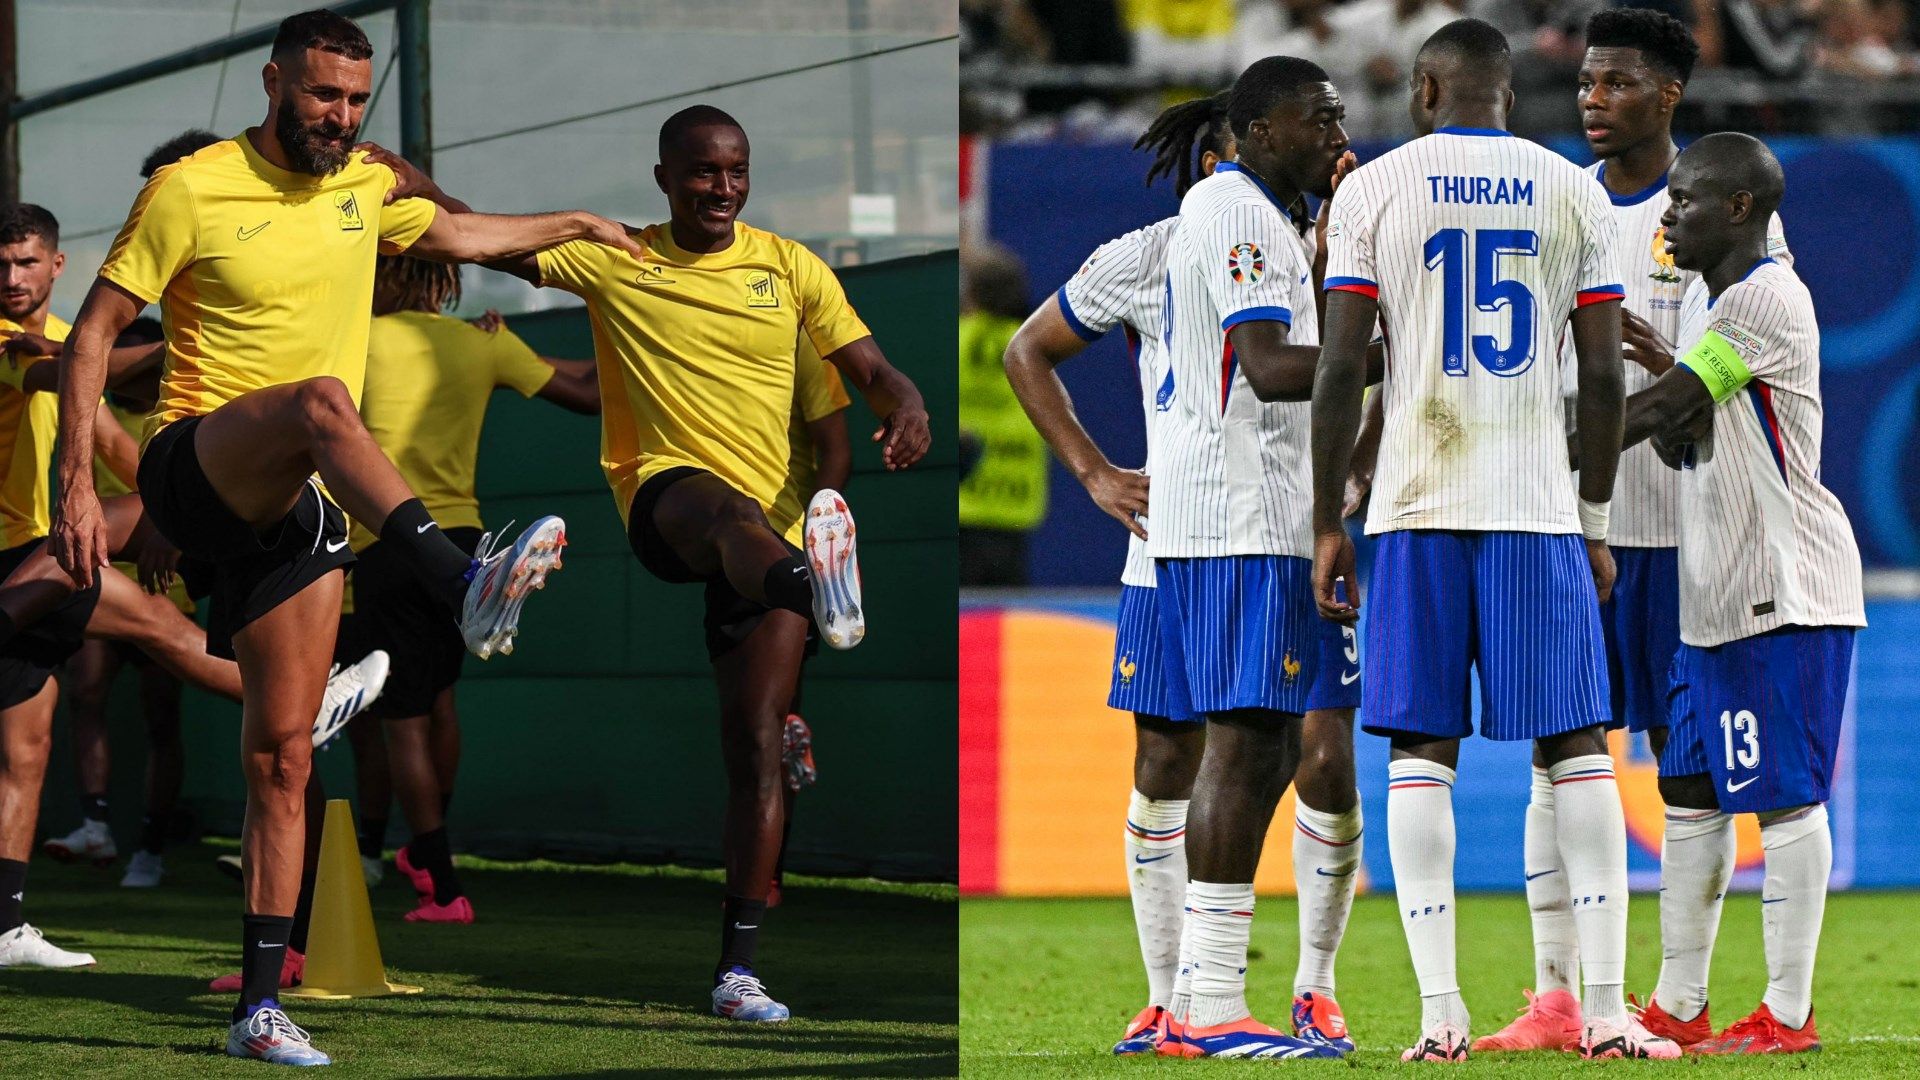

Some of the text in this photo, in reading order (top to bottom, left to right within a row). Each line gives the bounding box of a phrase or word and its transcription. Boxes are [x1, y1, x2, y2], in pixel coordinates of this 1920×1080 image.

[1427, 176, 1533, 206] THURAM
[1424, 228, 1539, 377] 15
[1717, 324, 1762, 351] FOUNDATION
[1709, 356, 1735, 389] RESPECT
[1720, 709, 1760, 770] 13
